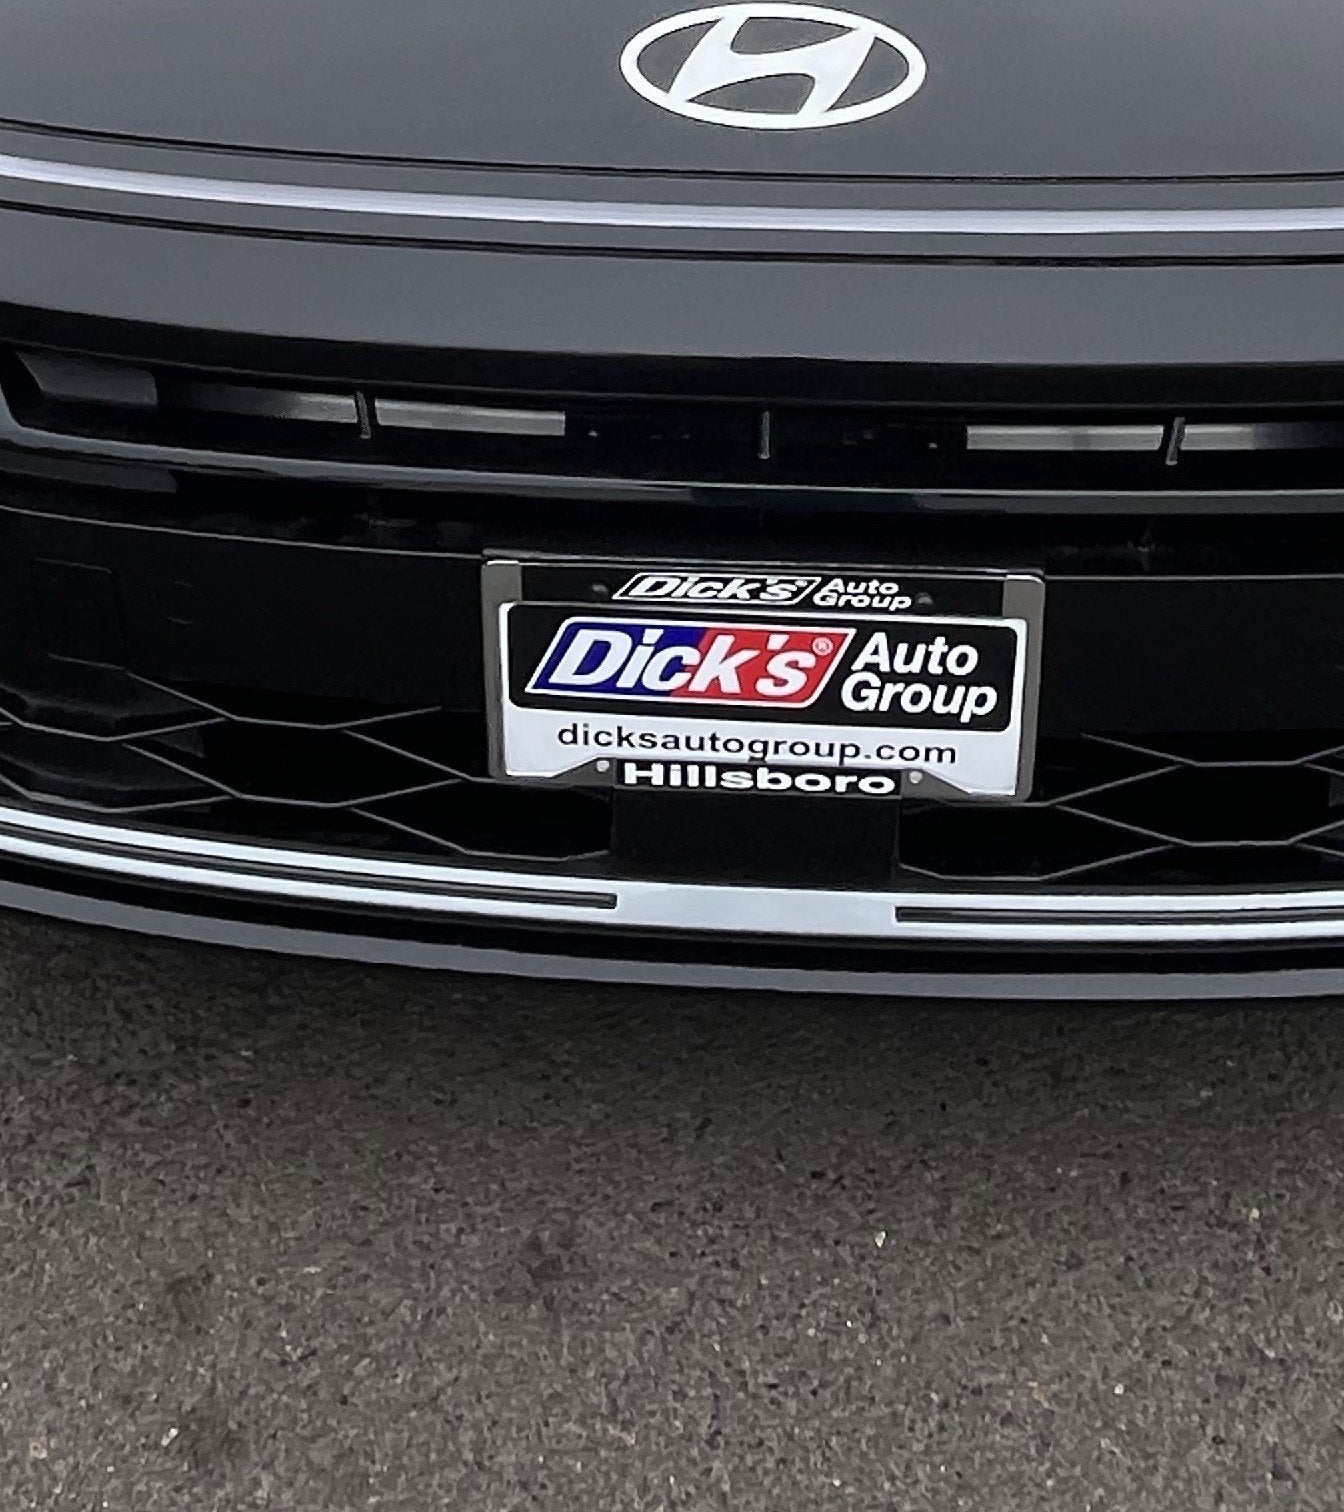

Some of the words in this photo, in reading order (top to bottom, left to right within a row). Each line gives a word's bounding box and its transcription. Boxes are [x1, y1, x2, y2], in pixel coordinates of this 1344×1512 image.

[633, 576, 800, 601] Dick's
[820, 577, 900, 597] Auto
[812, 591, 913, 612] Group
[547, 626, 817, 698] Dick's
[851, 631, 980, 677] Auto
[841, 671, 999, 724] Group
[557, 724, 957, 764] dicksautogroup.com
[622, 761, 897, 795] Hillsboro
